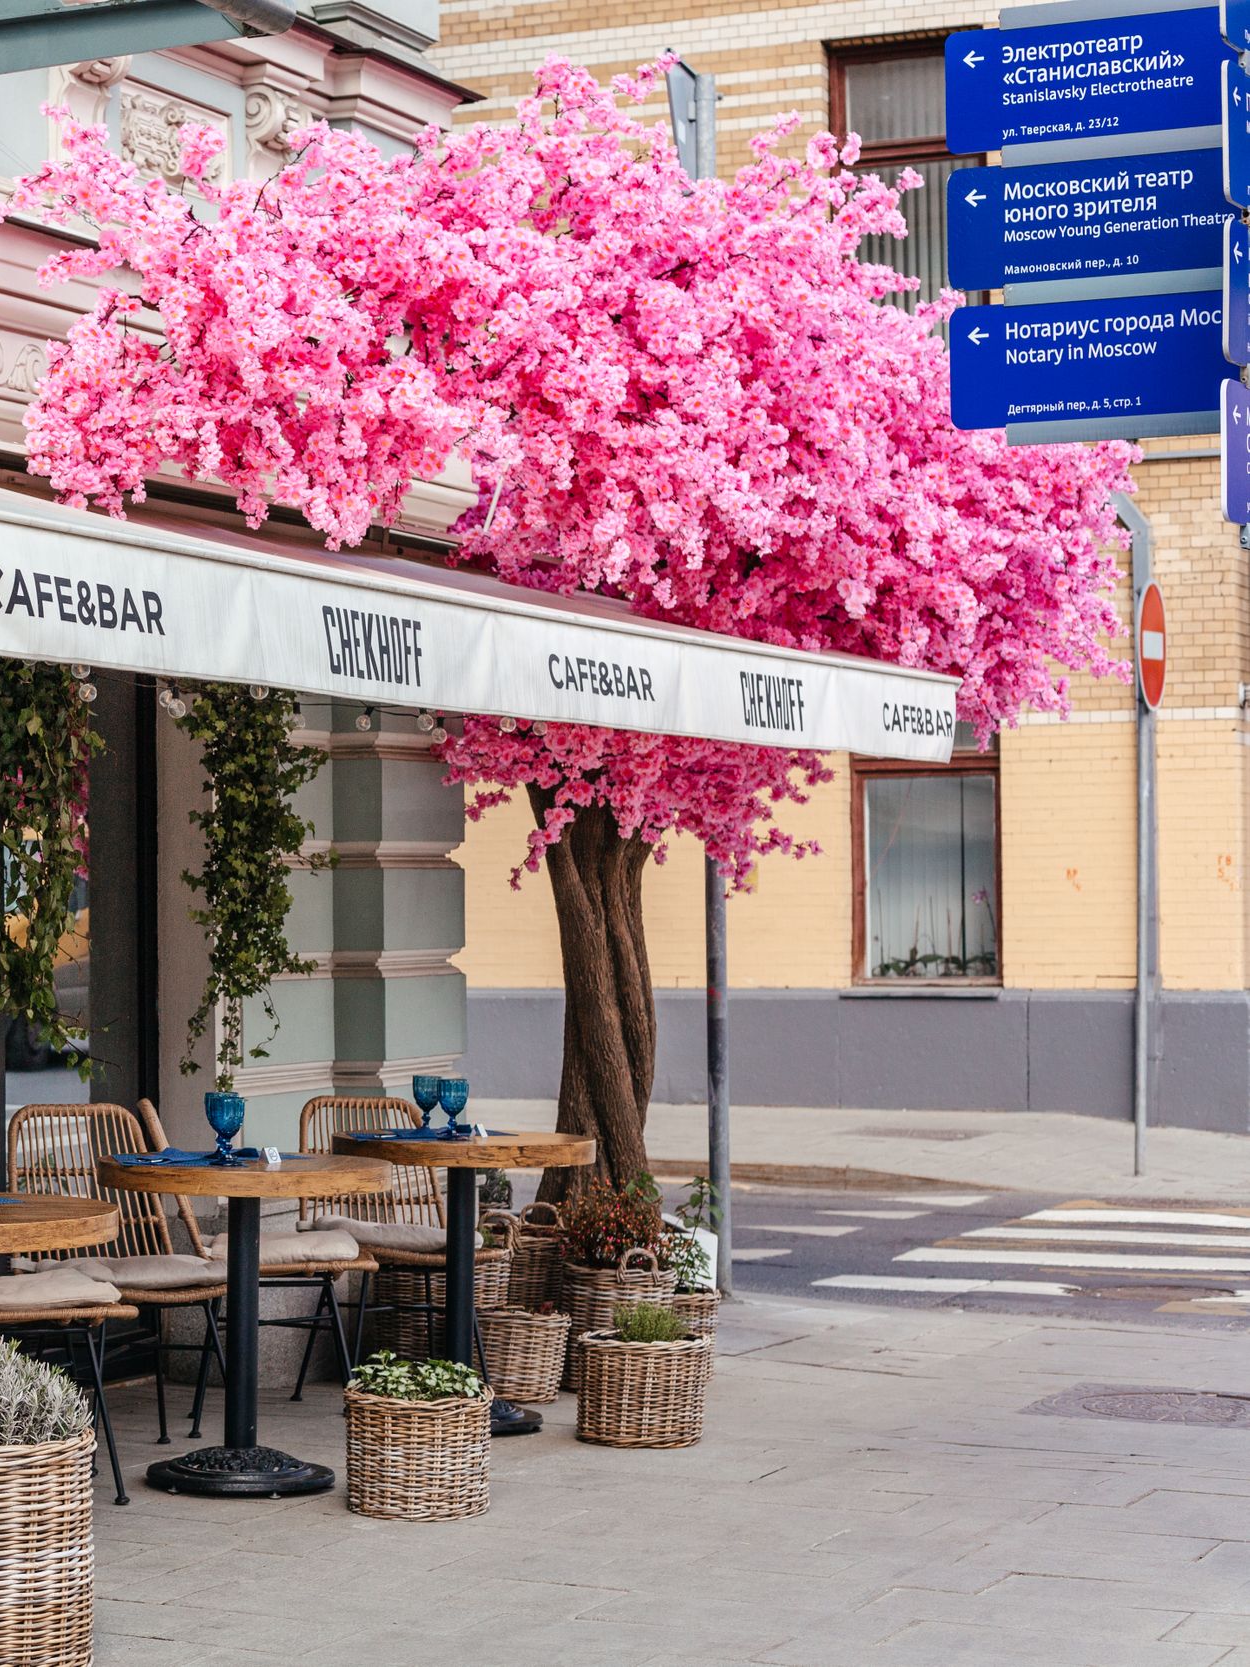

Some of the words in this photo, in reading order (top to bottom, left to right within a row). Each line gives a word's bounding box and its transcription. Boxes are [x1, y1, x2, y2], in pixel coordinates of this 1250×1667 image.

[1002, 34, 1143, 64] Электротеатр
[1003, 50, 1185, 86] «Станиславский»
[1002, 83, 1088, 105] Stanislavsky
[1091, 75, 1194, 97] Electrotheatre
[1002, 128, 1018, 140] ул.
[1021, 120, 1074, 136] Тверская,
[1075, 121, 1086, 132] д.
[1088, 116, 1119, 130] 23/12
[1004, 171, 1130, 201] Московский
[1134, 168, 1194, 190] театр
[1004, 202, 1069, 223] юного
[1073, 195, 1157, 219] зрителя
[1004, 228, 1056, 243] Moscow
[1058, 224, 1101, 239] Young
[1104, 216, 1179, 235] Generation
[1181, 212, 1235, 227] Theatre
[1004, 259, 1083, 275] Мамоновский
[1085, 257, 1112, 270] пер.,
[1113, 257, 1124, 268] д.
[1126, 255, 1139, 265] 10
[1006, 318, 1100, 341] Нотариус
[1104, 311, 1175, 334] города
[1006, 346, 1064, 366] Notary
[1068, 344, 1083, 360] in
[1088, 340, 1157, 359] Moscow
[1007, 400, 1064, 416] Дегтярный
[1067, 399, 1090, 412] пер.,
[1091, 399, 1102, 410] д.
[1103, 398, 1113, 409] 5,
[1114, 397, 1135, 410] стр.
[1136, 396, 1142, 406] 1
[322, 604, 422, 687] CHEKHOFF
[548, 653, 656, 702] CAFE&BAR
[739, 671, 804, 732] CHEKHOFF
[882, 702, 954, 738] CAFE&BAR
